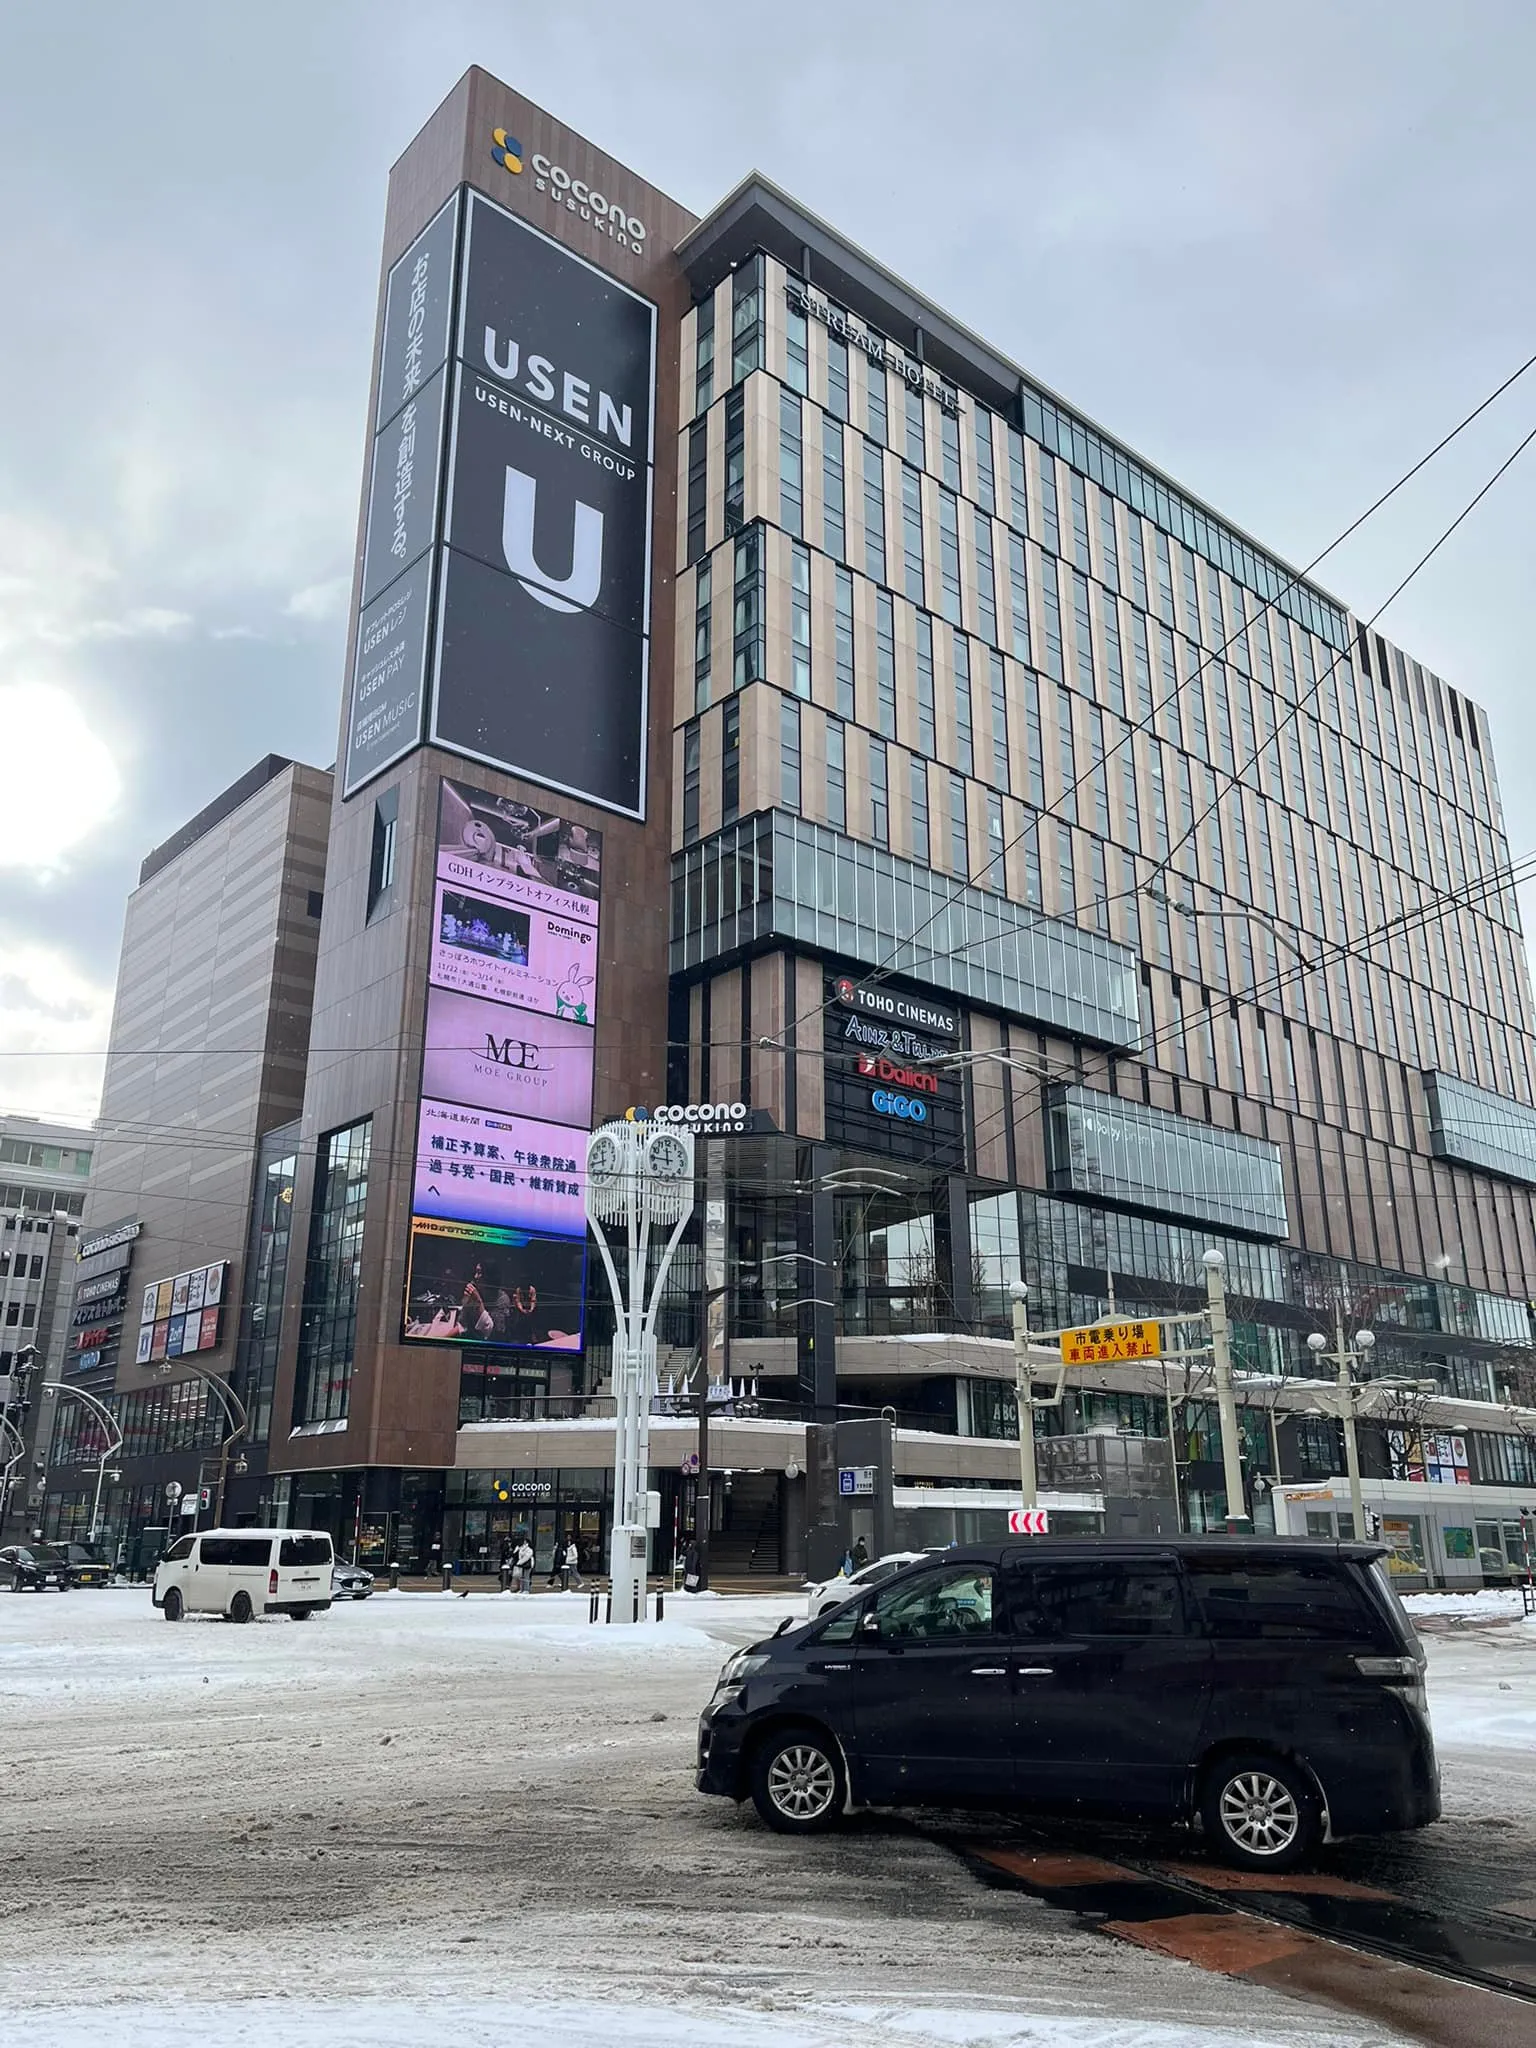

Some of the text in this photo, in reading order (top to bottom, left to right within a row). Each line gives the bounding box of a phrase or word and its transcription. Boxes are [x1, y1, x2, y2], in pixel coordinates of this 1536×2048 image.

[531, 153, 647, 242] cocono
[799, 291, 956, 410] STREAM HOTEL
[484, 325, 633, 447] USEN
[474, 385, 636, 481] USEN-NEXT GROUP
[363, 622, 389, 654] USEN
[359, 654, 406, 702] USEN PAY
[355, 718, 381, 749] USEN
[382, 691, 416, 729] MUSIC
[448, 862, 473, 878] GDH
[547, 921, 592, 945] Domingo
[858, 989, 954, 1032] TOHO CINEMAS
[484, 1032, 540, 1070] MOE
[473, 1064, 549, 1087] MOE GROUP
[425, 1107, 481, 1126] 北海道新聞
[653, 1102, 747, 1122] cocono
[872, 1089, 927, 1123] GiGO
[429, 1158, 443, 1174] 過
[1075, 1324, 1145, 1345] 市電乗り場
[1069, 1340, 1154, 1362] 車両進入禁止
[993, 1403, 1046, 1422] ABCRT
[512, 1483, 551, 1491] cocono
